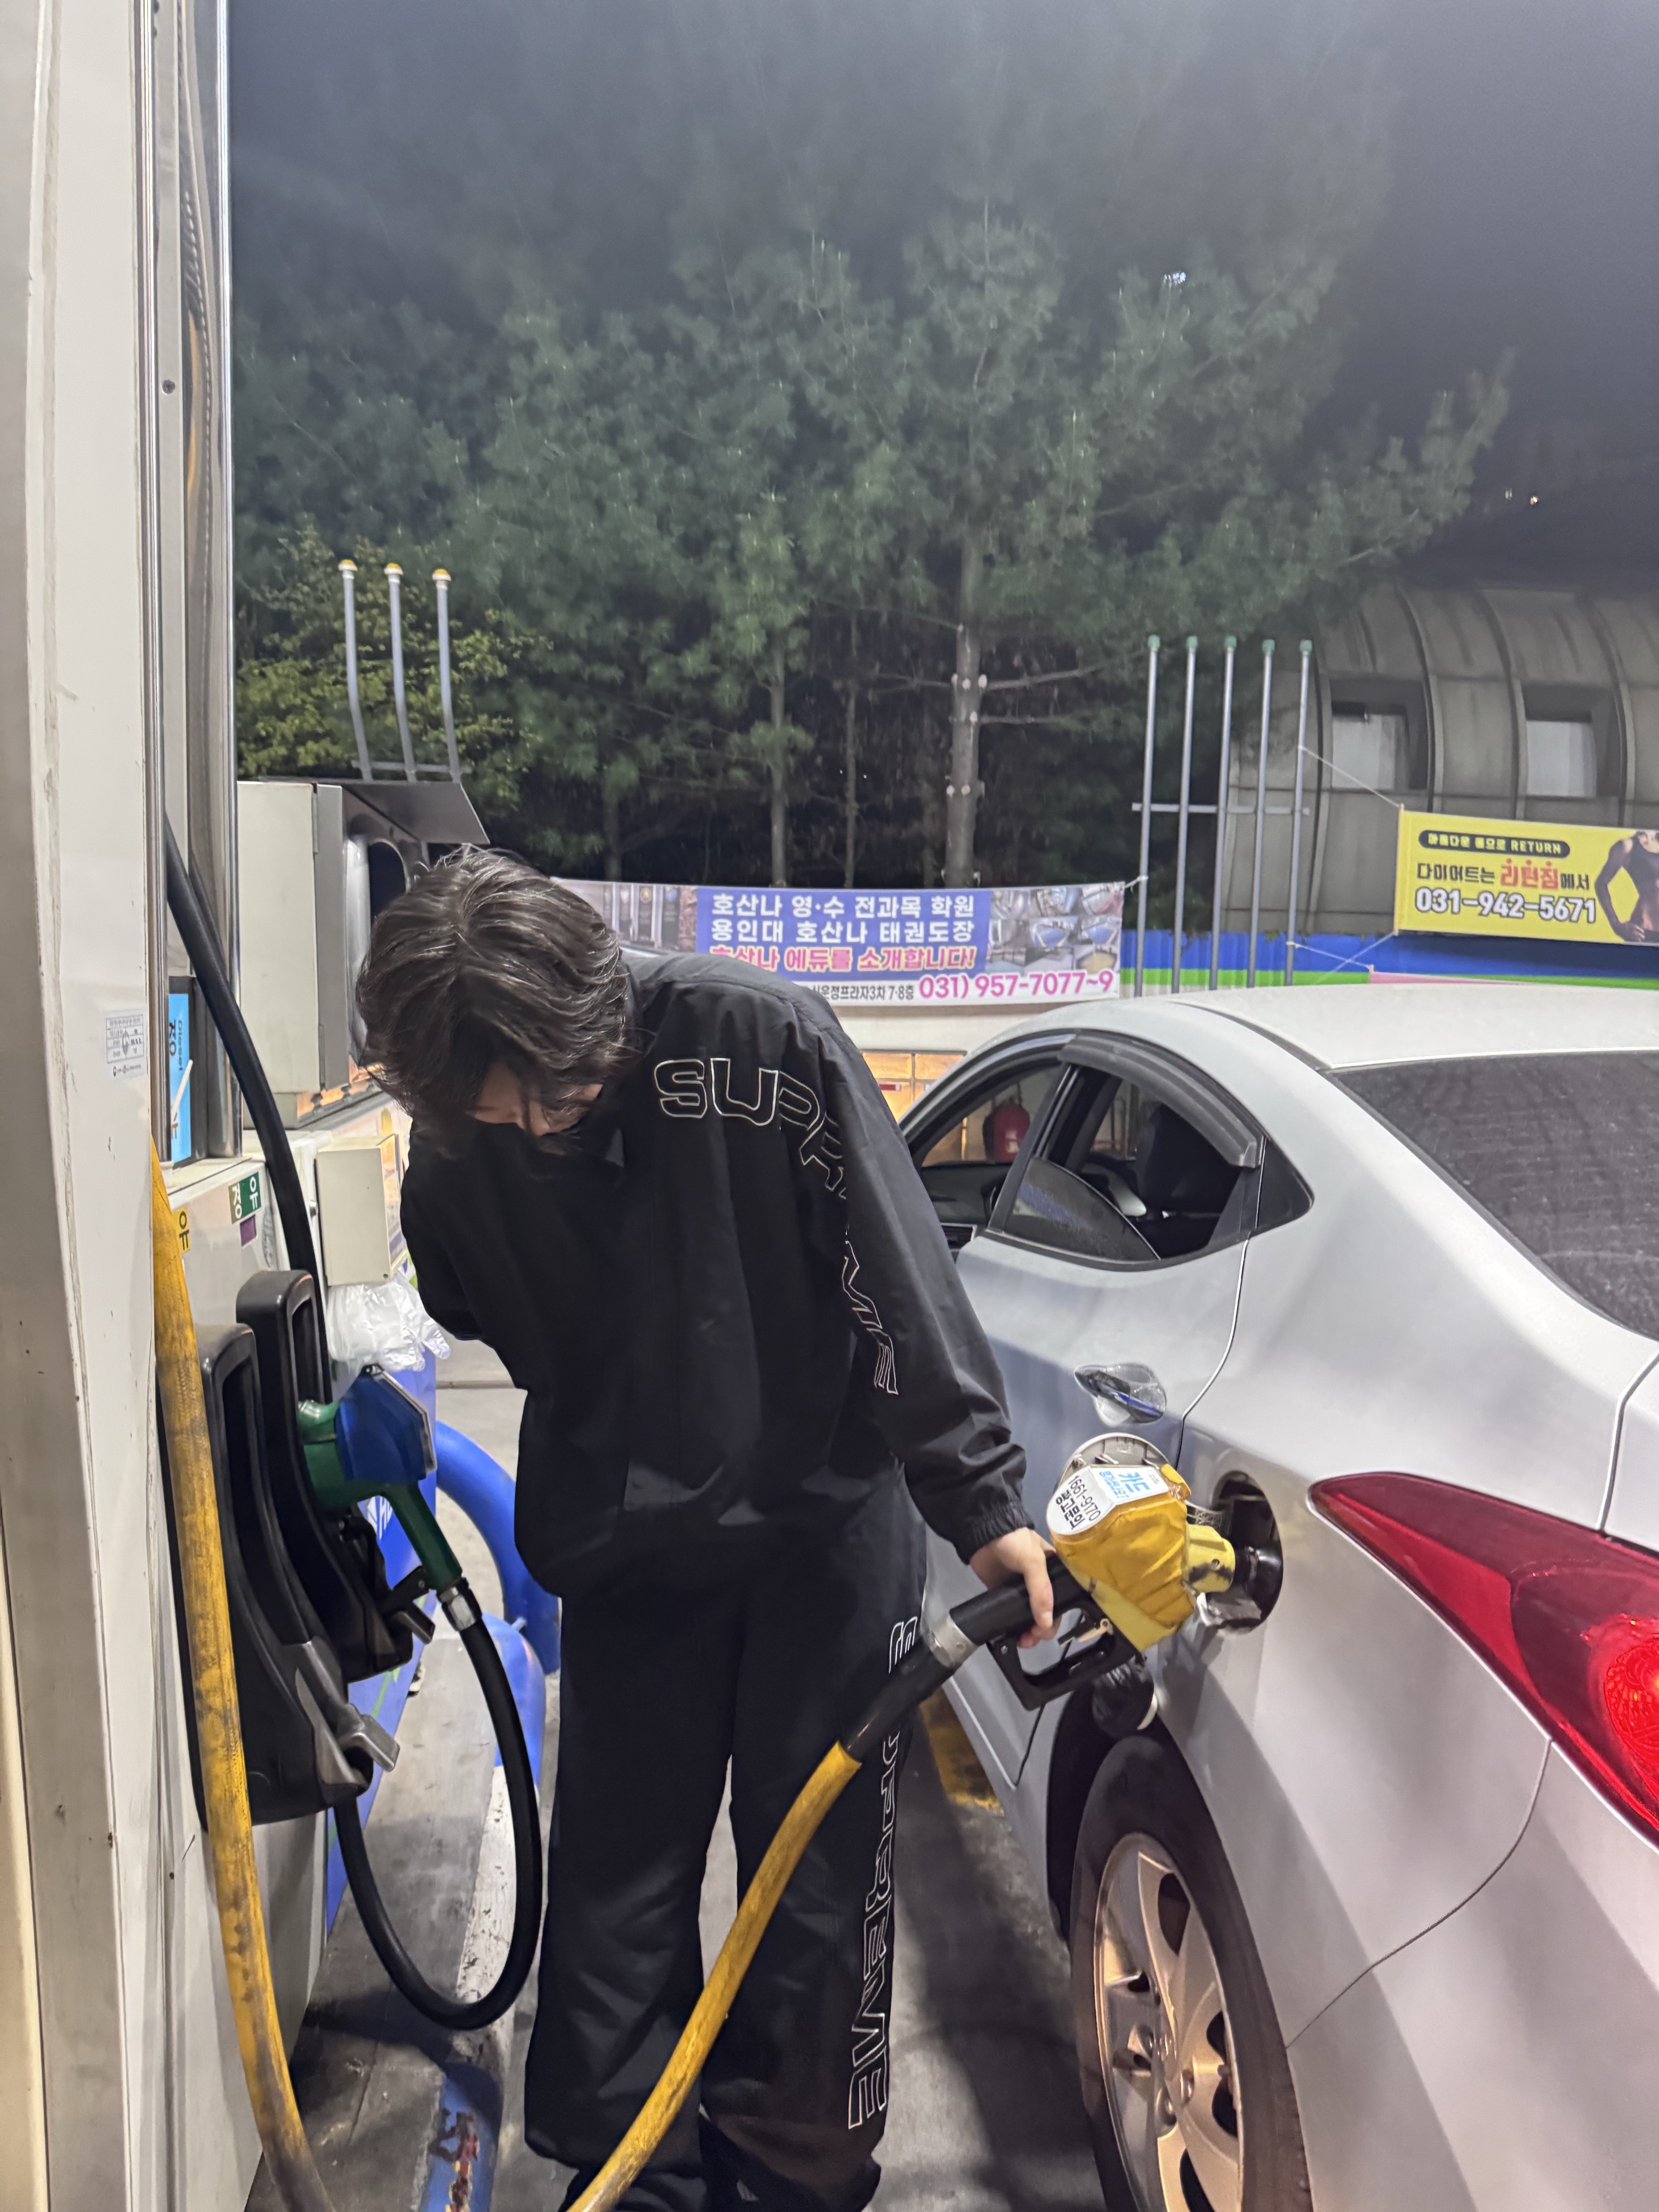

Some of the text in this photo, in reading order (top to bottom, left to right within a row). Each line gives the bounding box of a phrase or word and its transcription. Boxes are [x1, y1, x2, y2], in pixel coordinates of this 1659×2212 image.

[1510, 840, 1561, 855] RETURN
[1417, 863, 1495, 884] 다이어트는
[712, 893, 783, 917] 호산나
[855, 895, 921, 919] 전과목
[931, 895, 974, 918] 학원
[1415, 887, 1596, 923] 031-942-5671
[711, 918, 975, 944] 용인대 호산나 태권도장
[857, 945, 977, 971] 소개합니다!
[232, 1176, 258, 1219] 경유
[1118, 1472, 1151, 1493] 카드
[1056, 1489, 1085, 1530] 광고문의
[1068, 1475, 1101, 1521] 1661-9170
